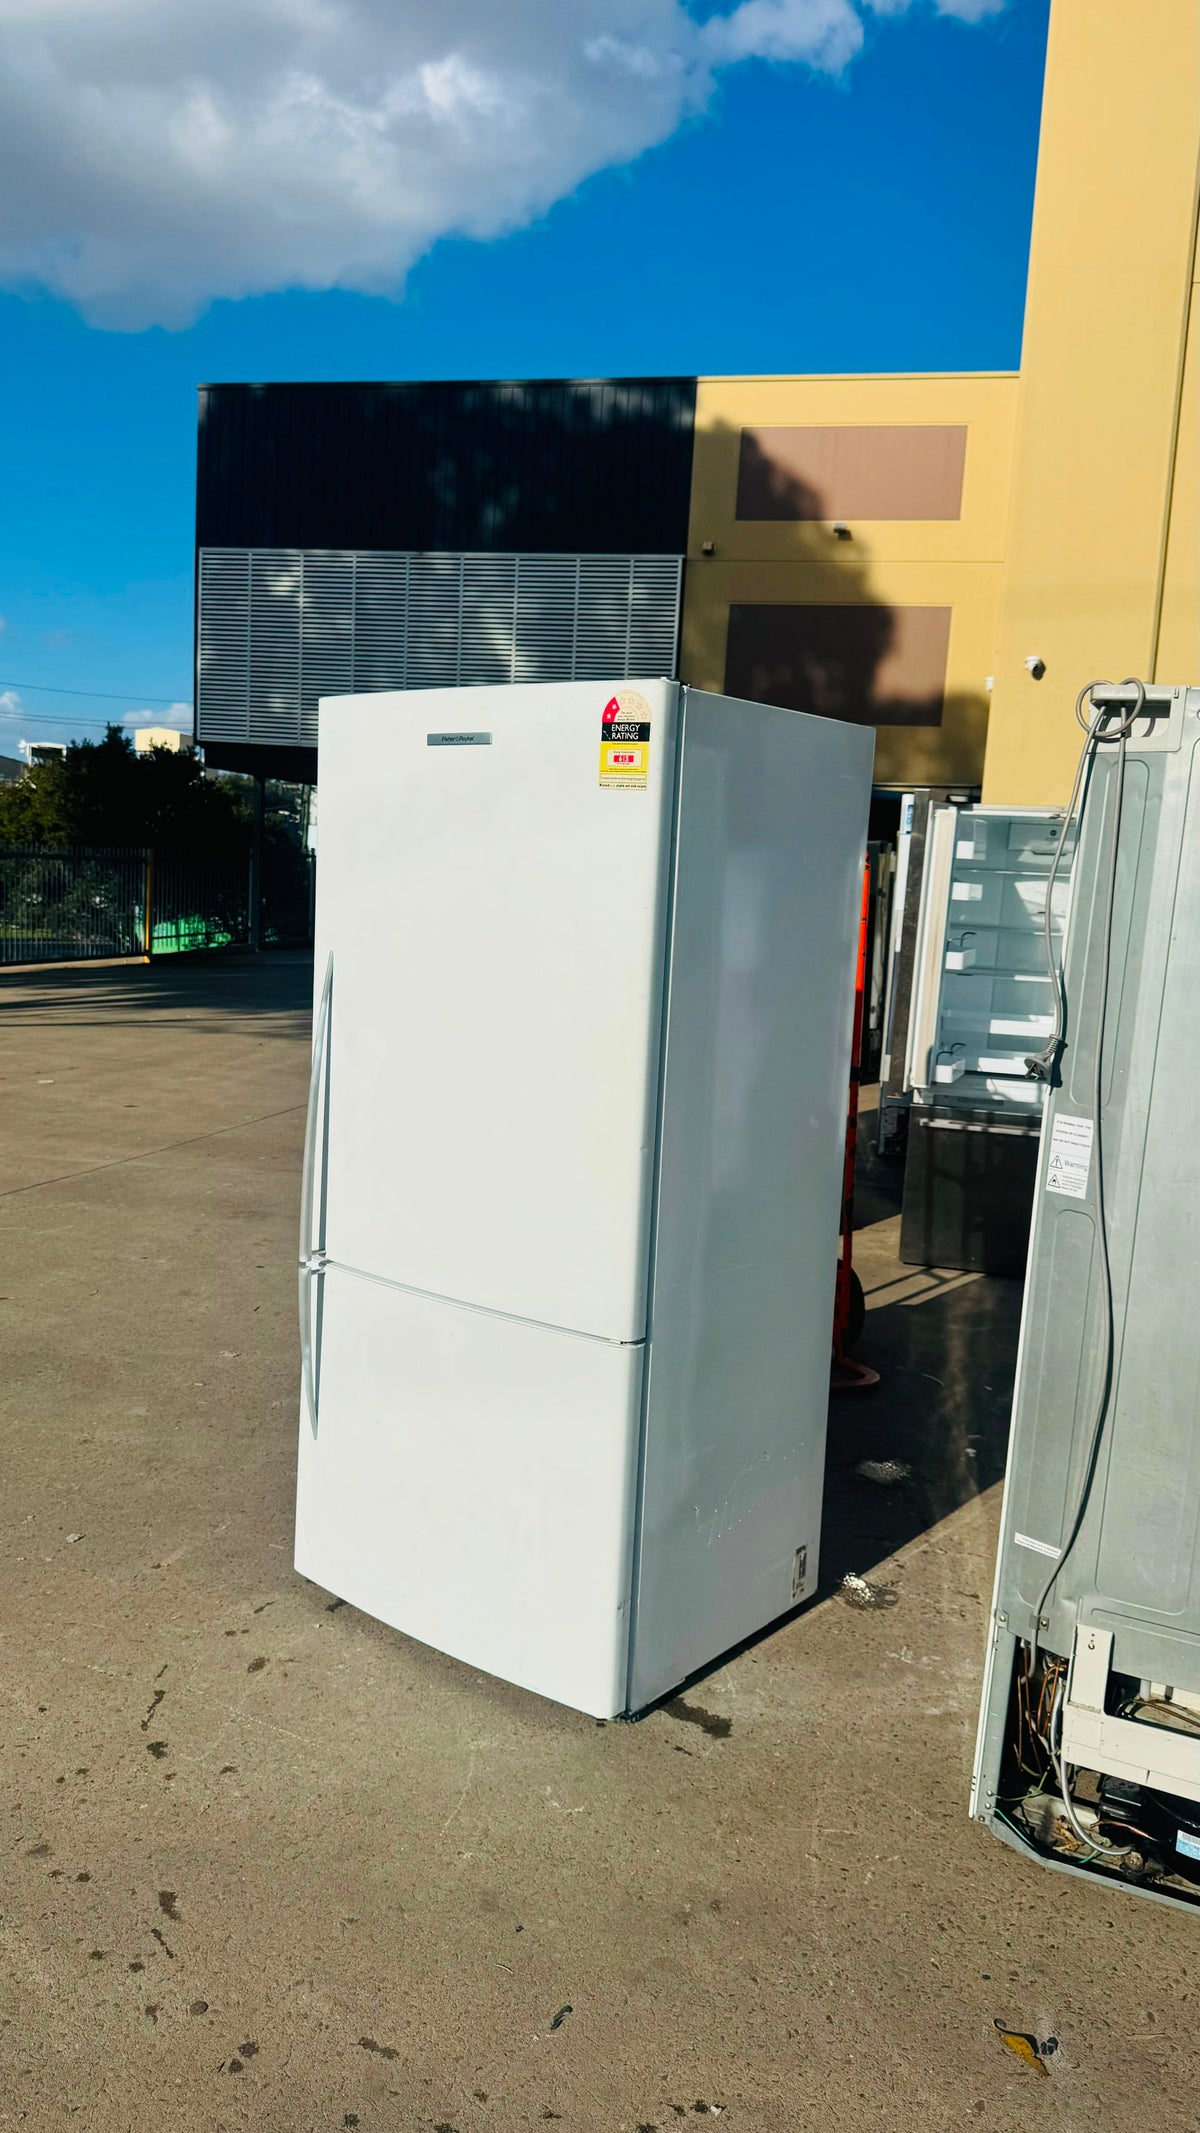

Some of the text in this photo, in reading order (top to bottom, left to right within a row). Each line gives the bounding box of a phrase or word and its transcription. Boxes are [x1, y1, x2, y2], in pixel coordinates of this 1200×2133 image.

[611, 724, 640, 732] ENERGY
[611, 732, 639, 740] RATING
[1064, 1159, 1088, 1172] Warning
